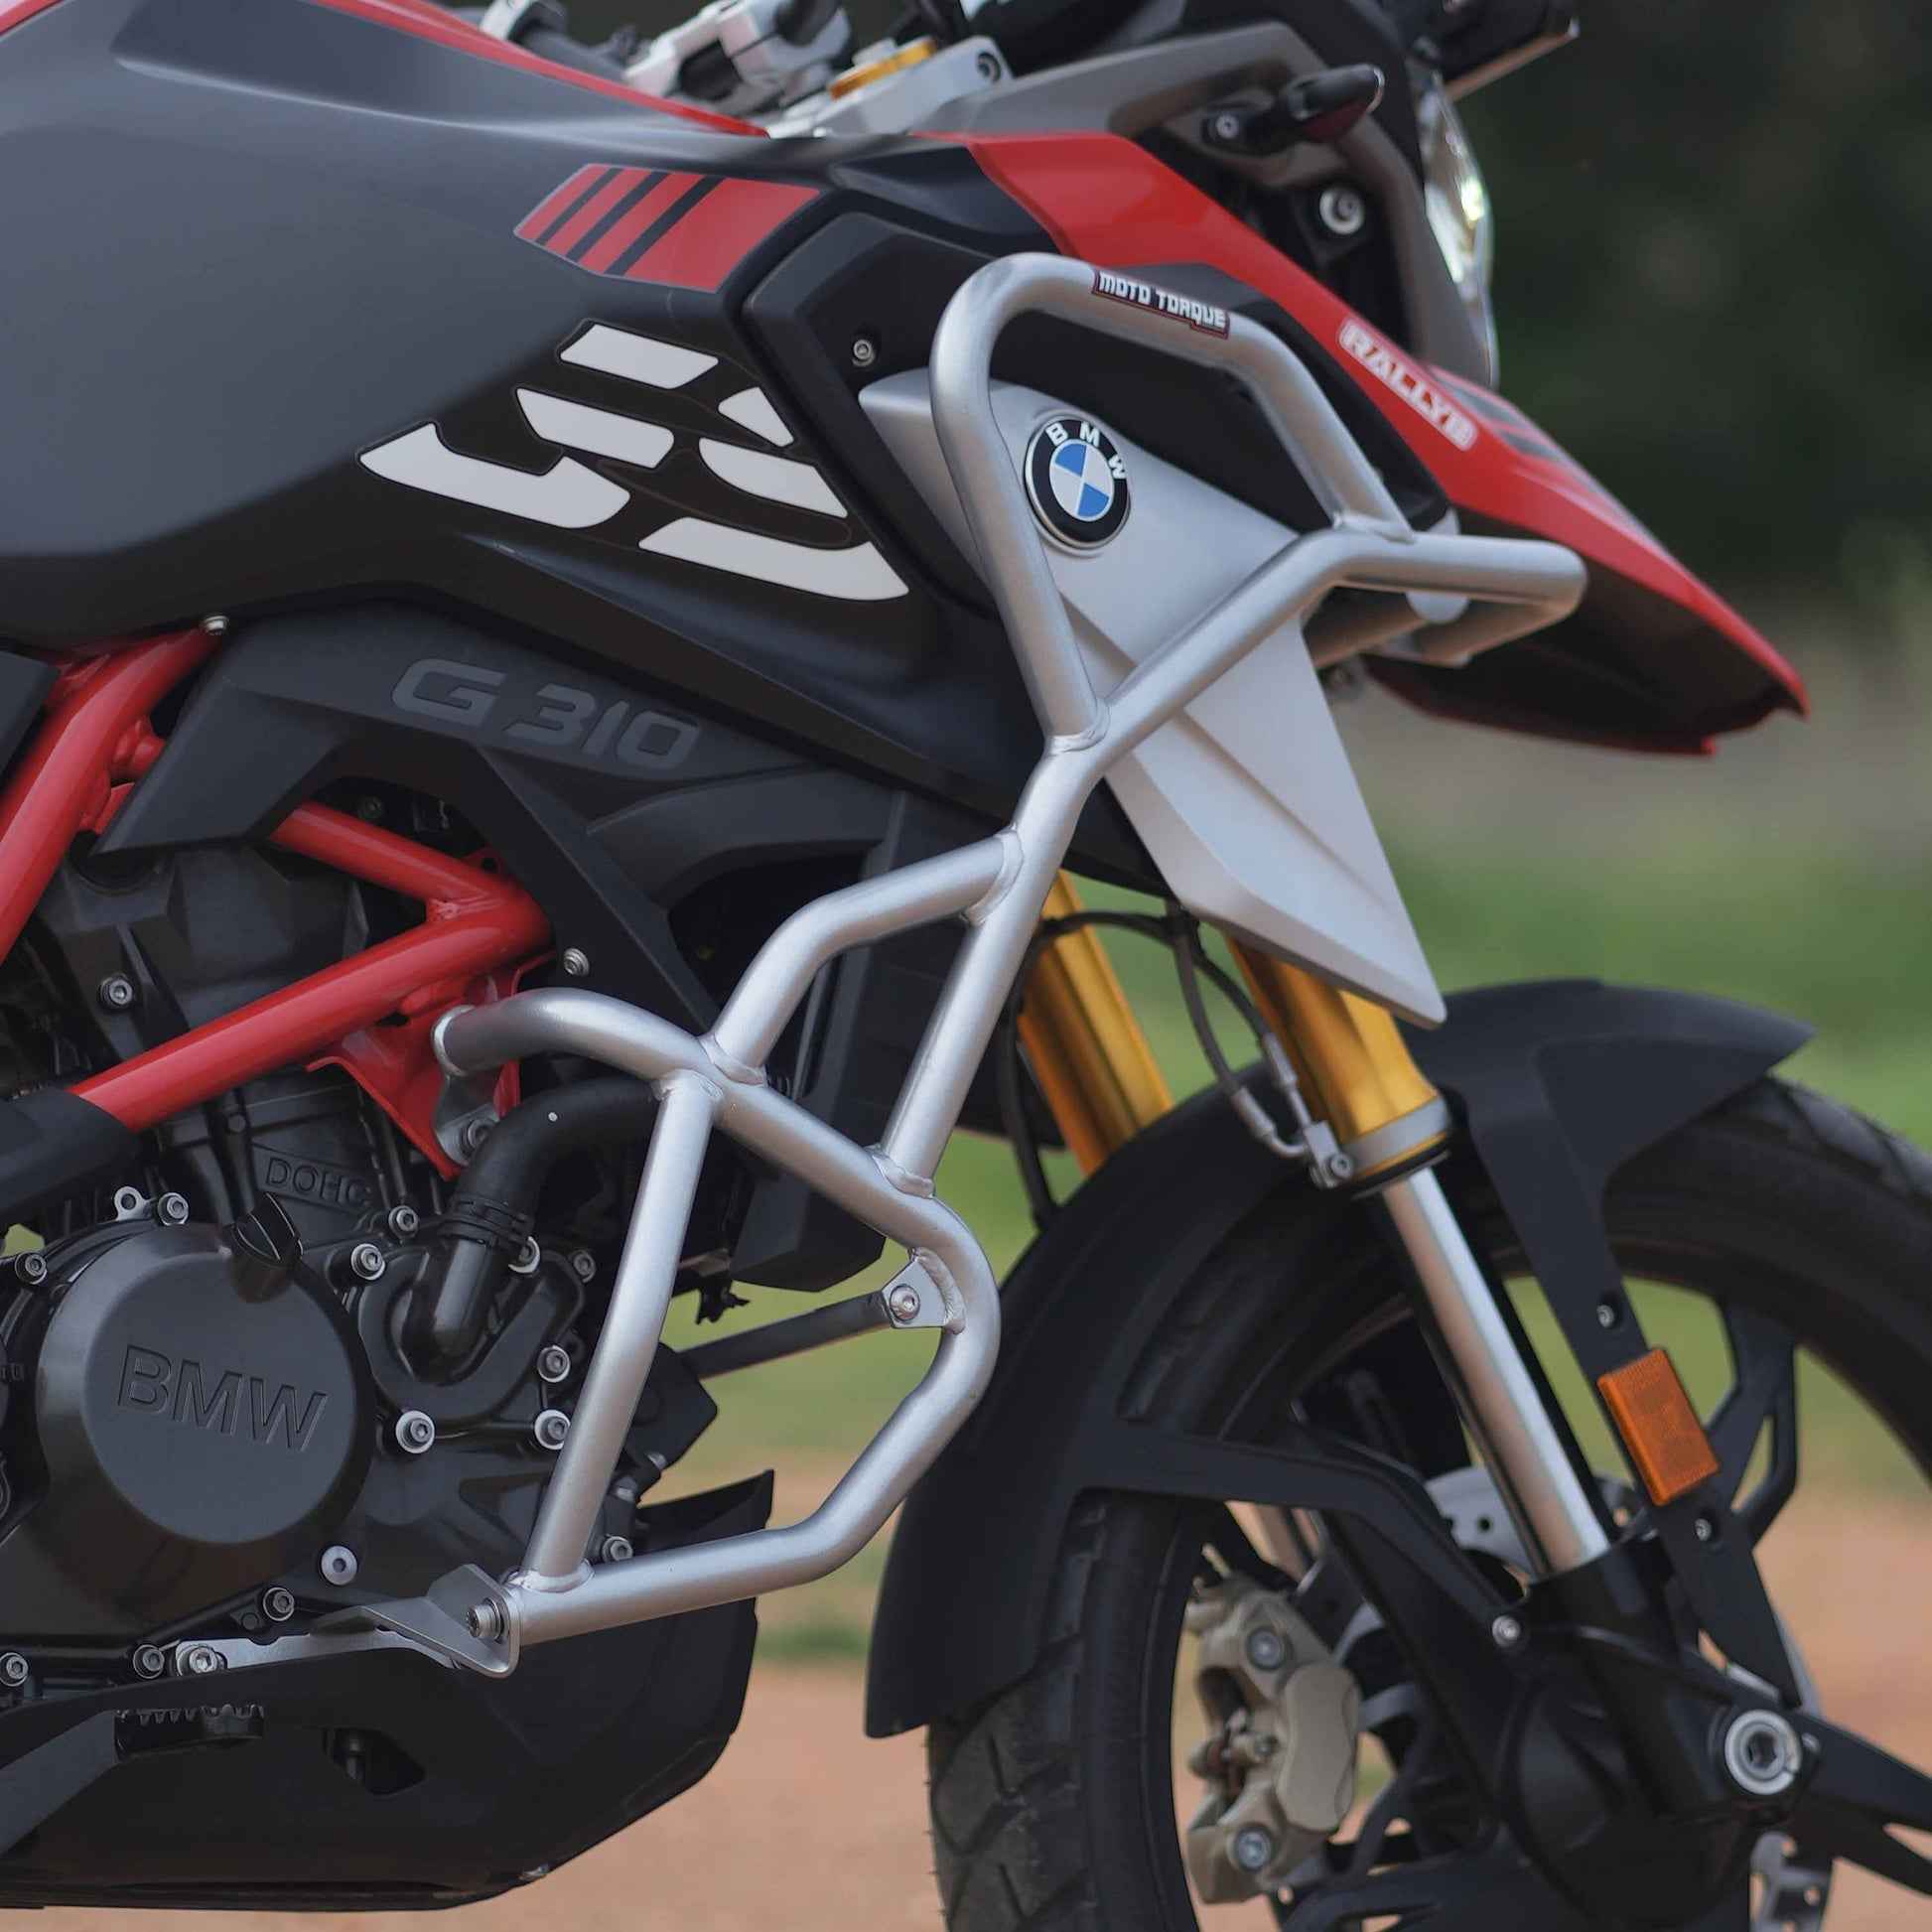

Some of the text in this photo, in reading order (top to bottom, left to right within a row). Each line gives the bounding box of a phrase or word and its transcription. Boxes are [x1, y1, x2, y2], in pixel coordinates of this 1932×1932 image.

[1098, 271, 1226, 329] MOTO TORQUE
[1045, 420, 1127, 480] BMW
[392, 658, 701, 771] G 310
[265, 1157, 367, 1205] DOHC
[117, 1344, 329, 1452] BMW
